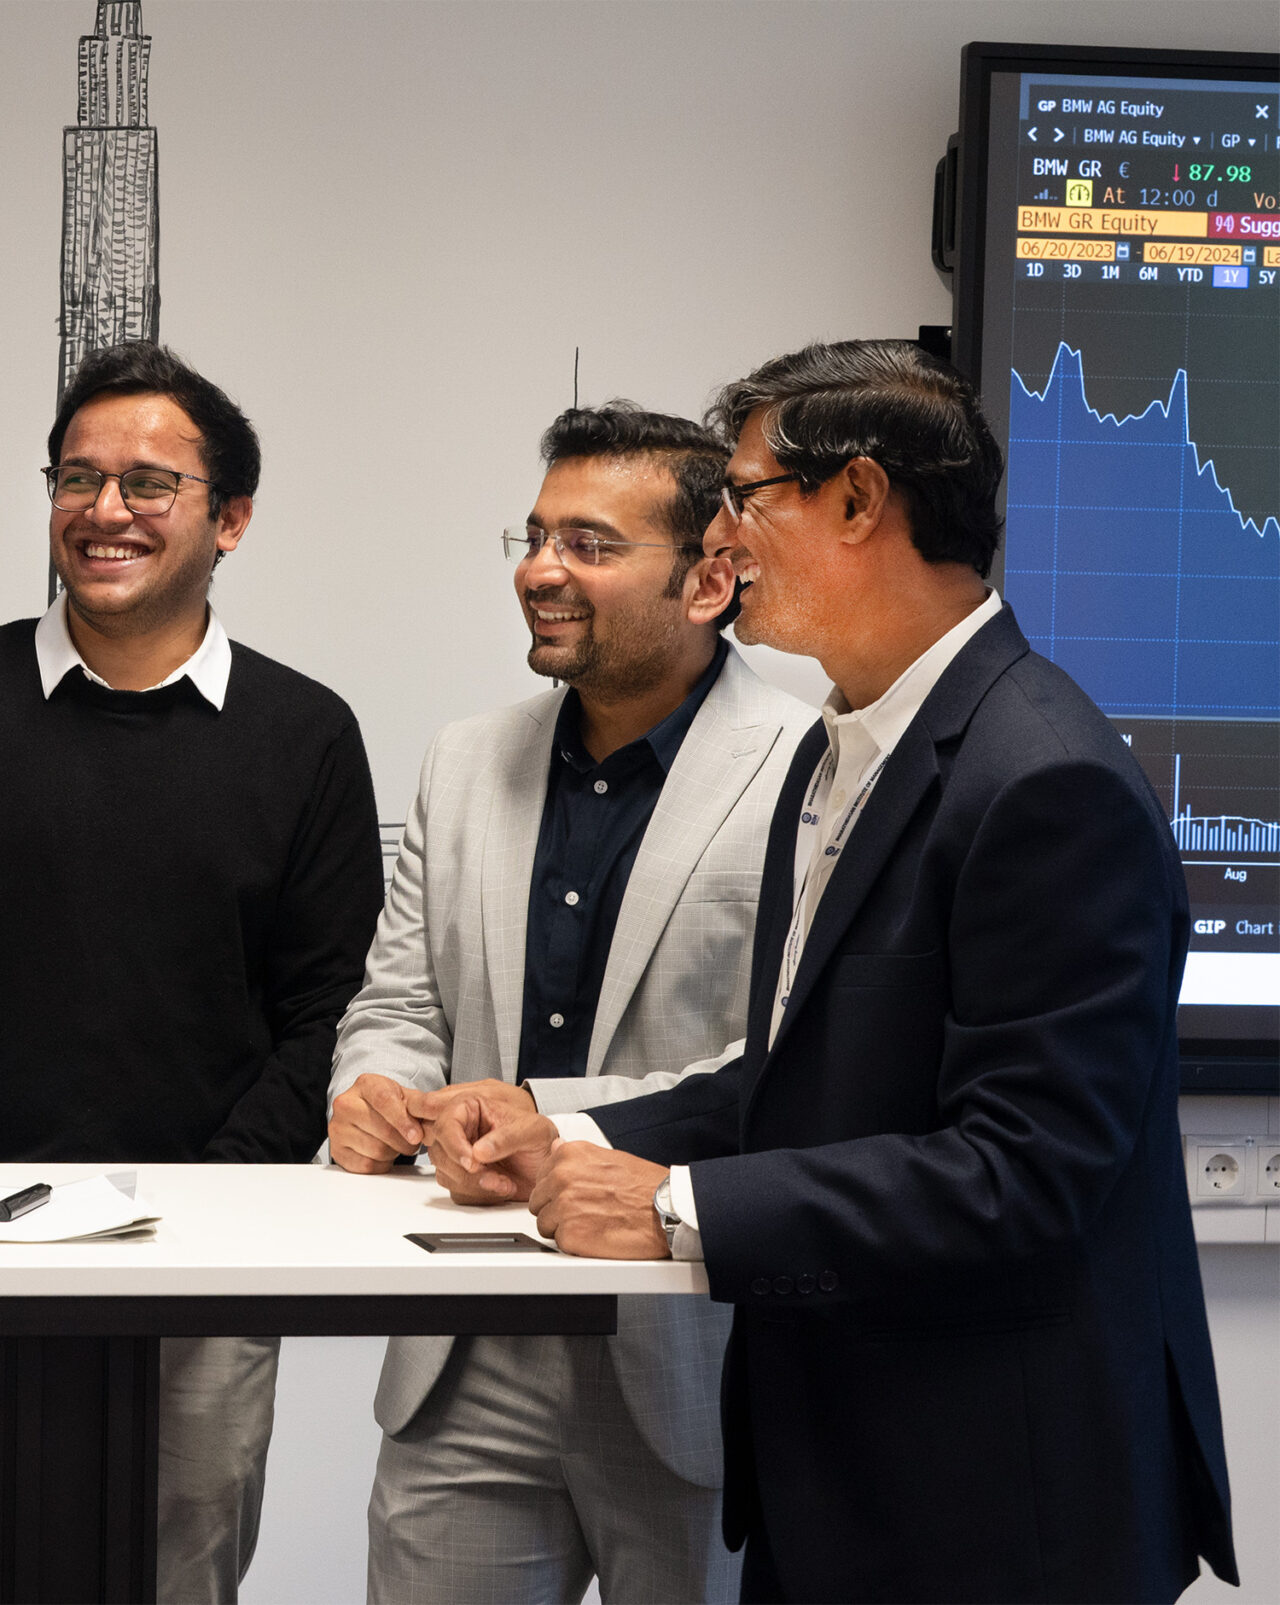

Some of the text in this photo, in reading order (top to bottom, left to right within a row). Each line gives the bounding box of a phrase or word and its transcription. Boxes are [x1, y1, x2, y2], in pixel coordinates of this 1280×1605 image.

[1037, 99, 1164, 118] GP BMW AG Equity
[1084, 129, 1186, 147] BMW AG Equity
[1221, 134, 1241, 148] GP
[1033, 158, 1131, 178] BMW GR €
[1189, 163, 1252, 183] 87.98
[1103, 187, 1126, 204] At
[1139, 188, 1196, 206] 12:00
[1207, 190, 1218, 207] d
[1022, 211, 1158, 235] BMW GR Equity
[1021, 241, 1240, 264] 06/20/2023 06/19/2024
[1026, 264, 1276, 285] 1D 3D 1M 6M YTD 1Y 5Y
[1224, 867, 1247, 882] Aug
[1194, 919, 1226, 934] GIP
[1235, 920, 1273, 935] Chart
